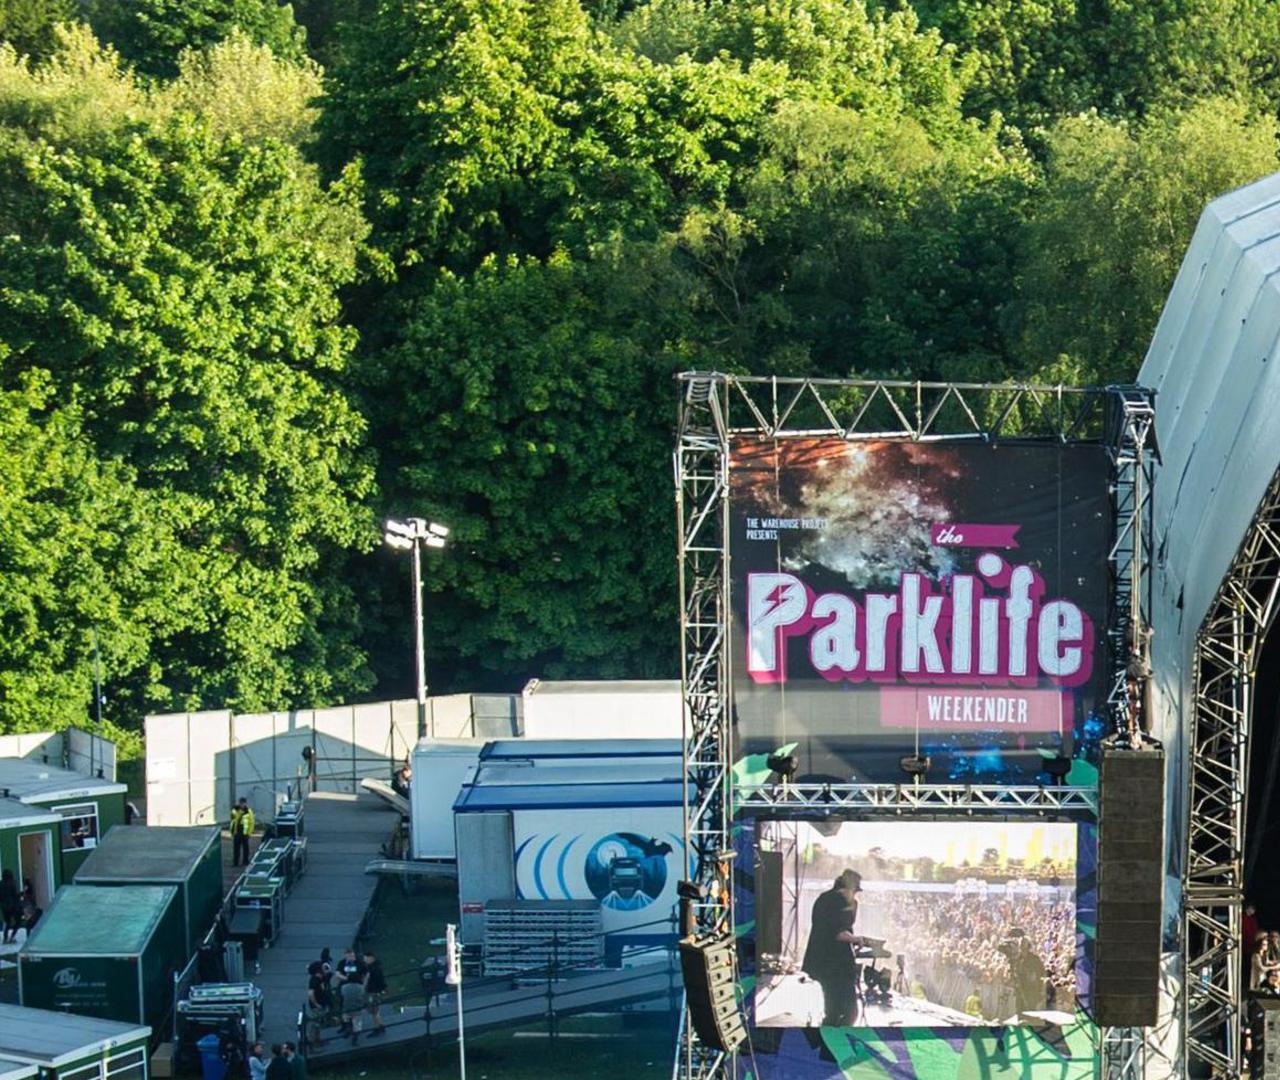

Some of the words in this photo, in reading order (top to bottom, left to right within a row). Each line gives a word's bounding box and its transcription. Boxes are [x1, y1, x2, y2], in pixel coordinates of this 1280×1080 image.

[747, 517, 759, 529] THE
[761, 518, 799, 529] WAREHOUSE
[746, 529, 778, 540] PRESENTS
[936, 525, 964, 545] the
[747, 553, 1085, 678] Parklife
[928, 694, 1028, 724] WEEKENDER
